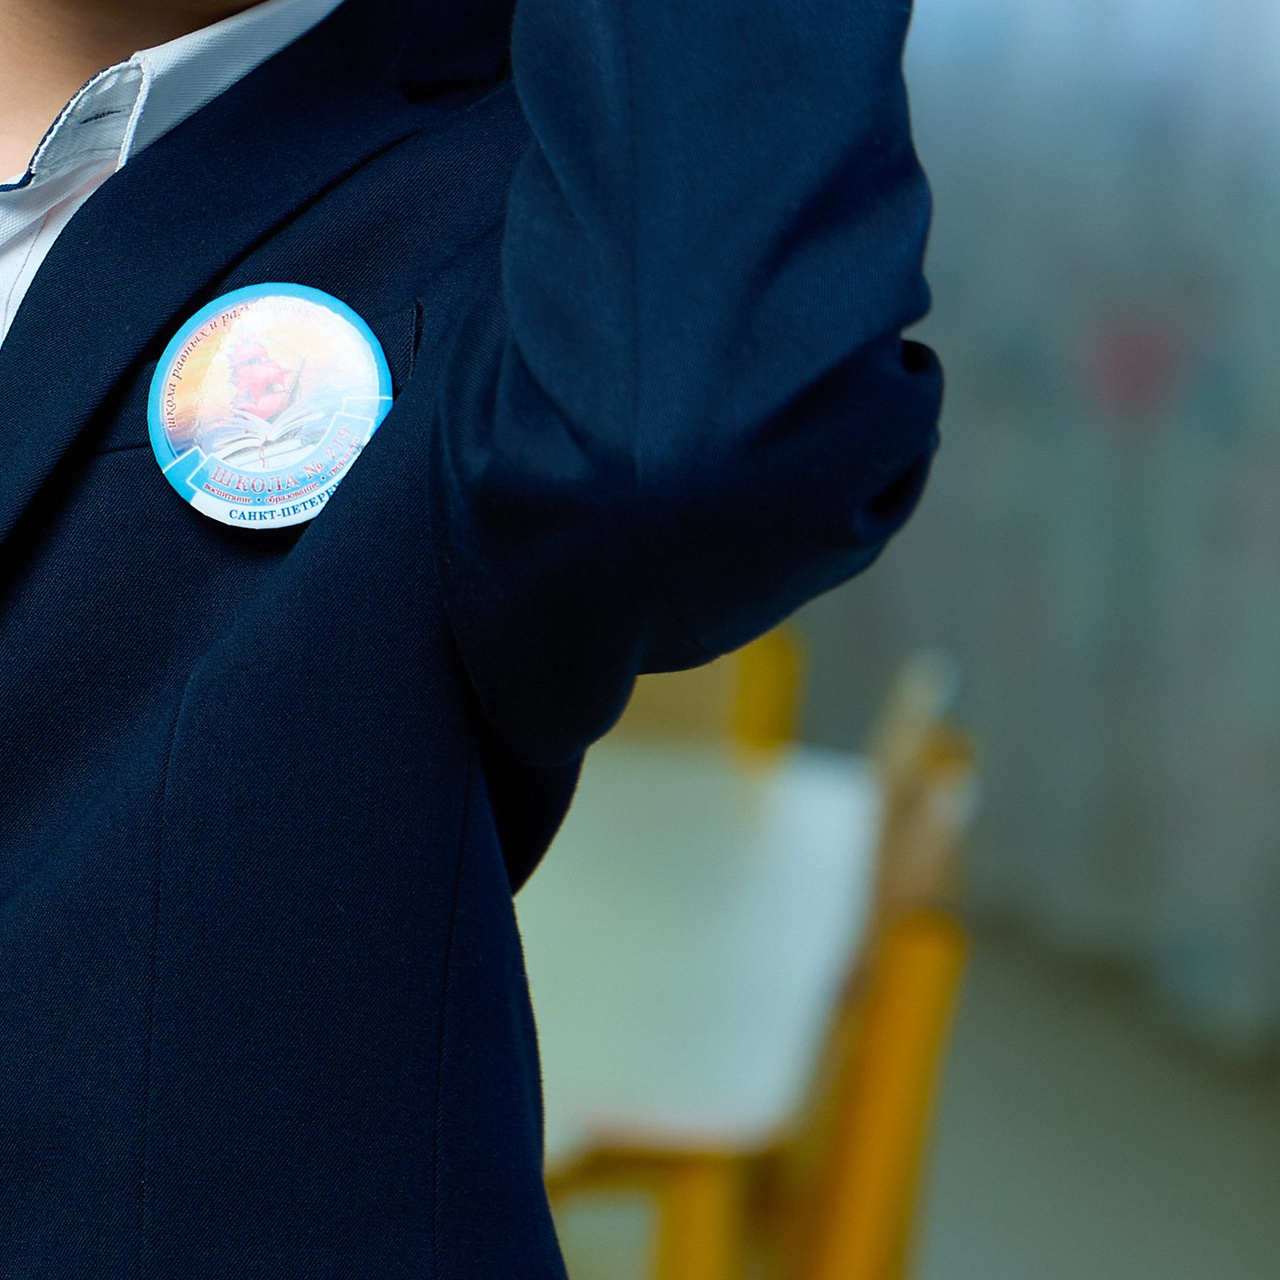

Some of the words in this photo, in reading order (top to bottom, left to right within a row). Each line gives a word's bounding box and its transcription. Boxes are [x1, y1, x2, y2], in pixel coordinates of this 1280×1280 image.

[165, 383, 177, 430] школа
[172, 328, 210, 380] равных
[209, 320, 218, 331] и
[204, 483, 253, 504] воспитание
[265, 481, 319, 505] образование
[210, 465, 300, 494] ШКОЛА
[302, 461, 324, 479] №
[325, 425, 351, 461] 219
